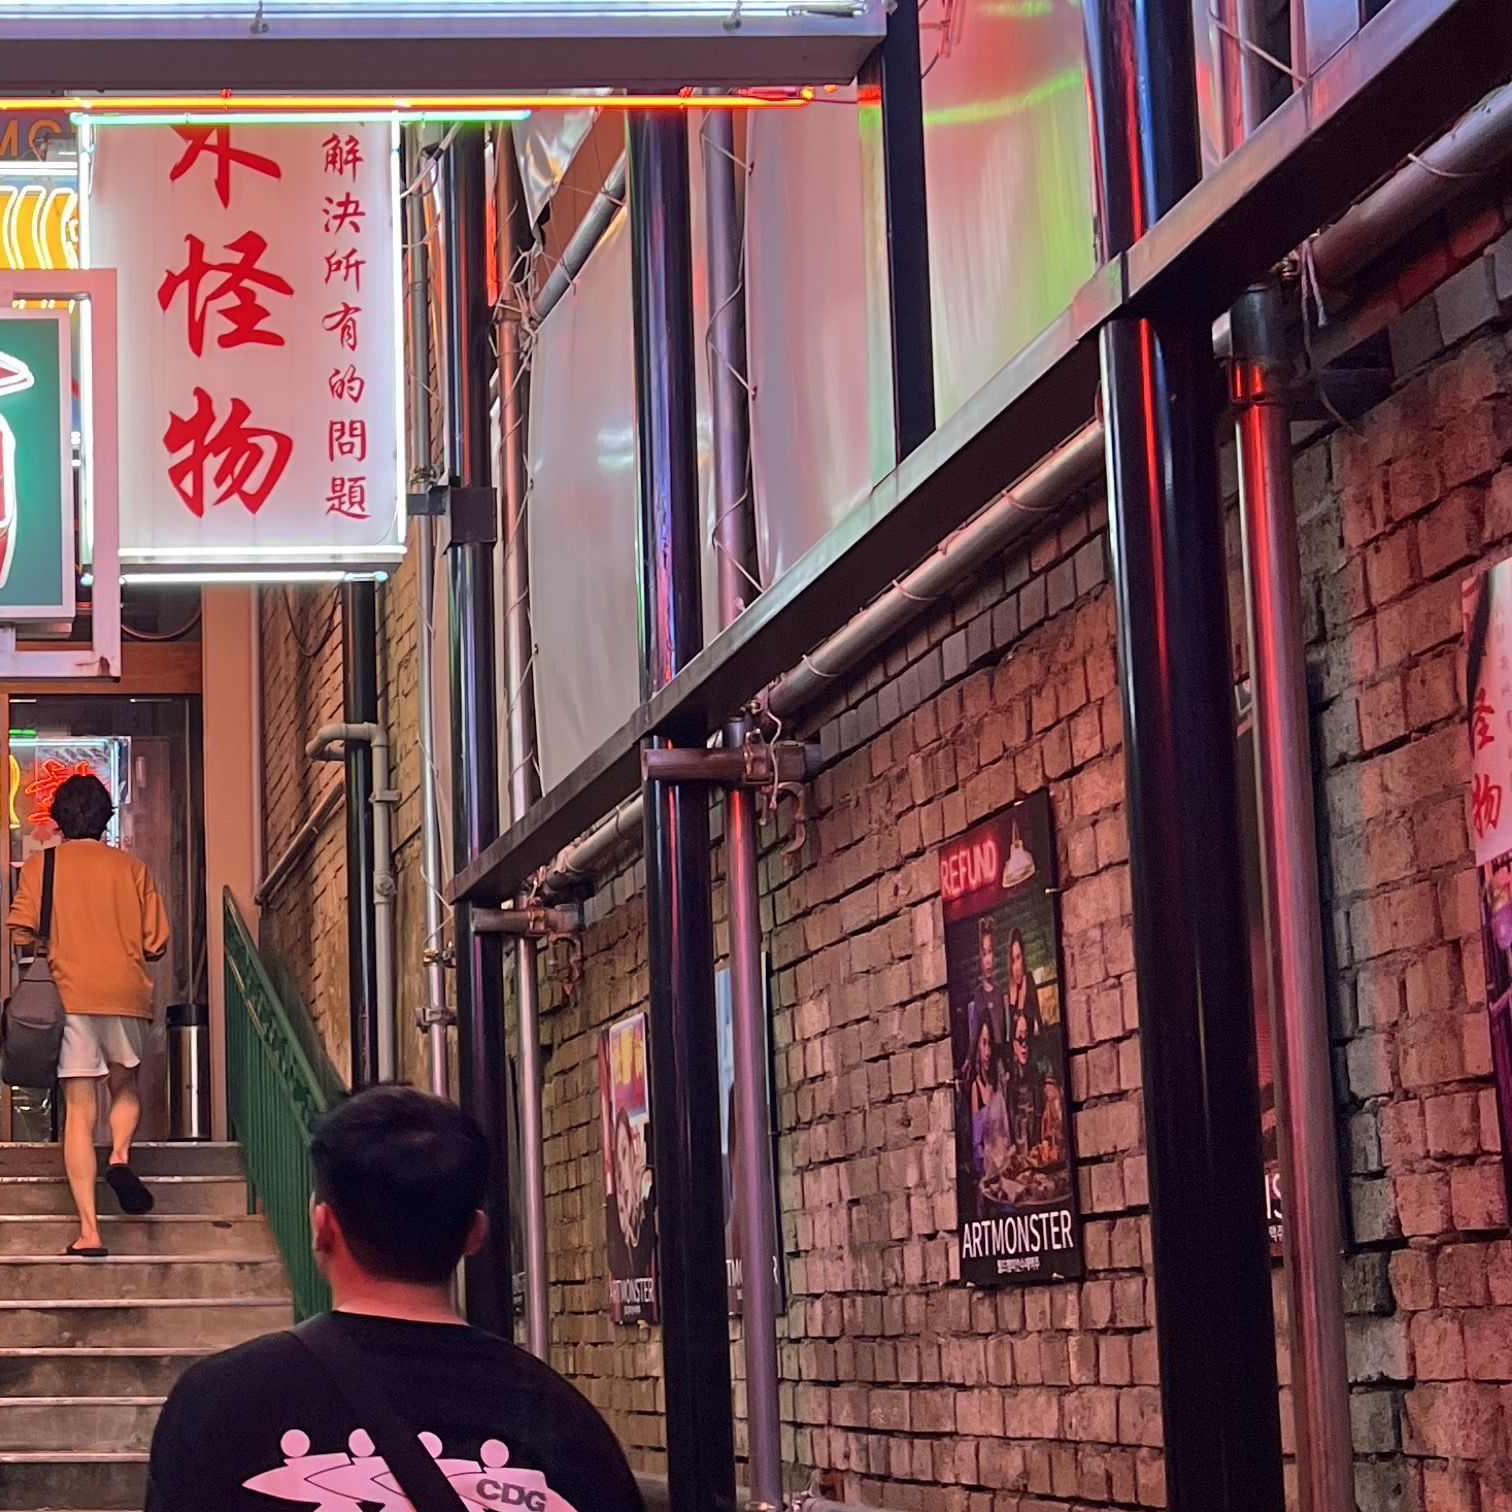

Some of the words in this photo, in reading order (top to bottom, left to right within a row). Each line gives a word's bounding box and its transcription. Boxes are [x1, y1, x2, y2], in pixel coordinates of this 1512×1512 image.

[321, 132, 371, 521] 解決所有的問題
[941, 840, 997, 899] REFUND
[962, 1209, 1074, 1259] ARTMONSTER
